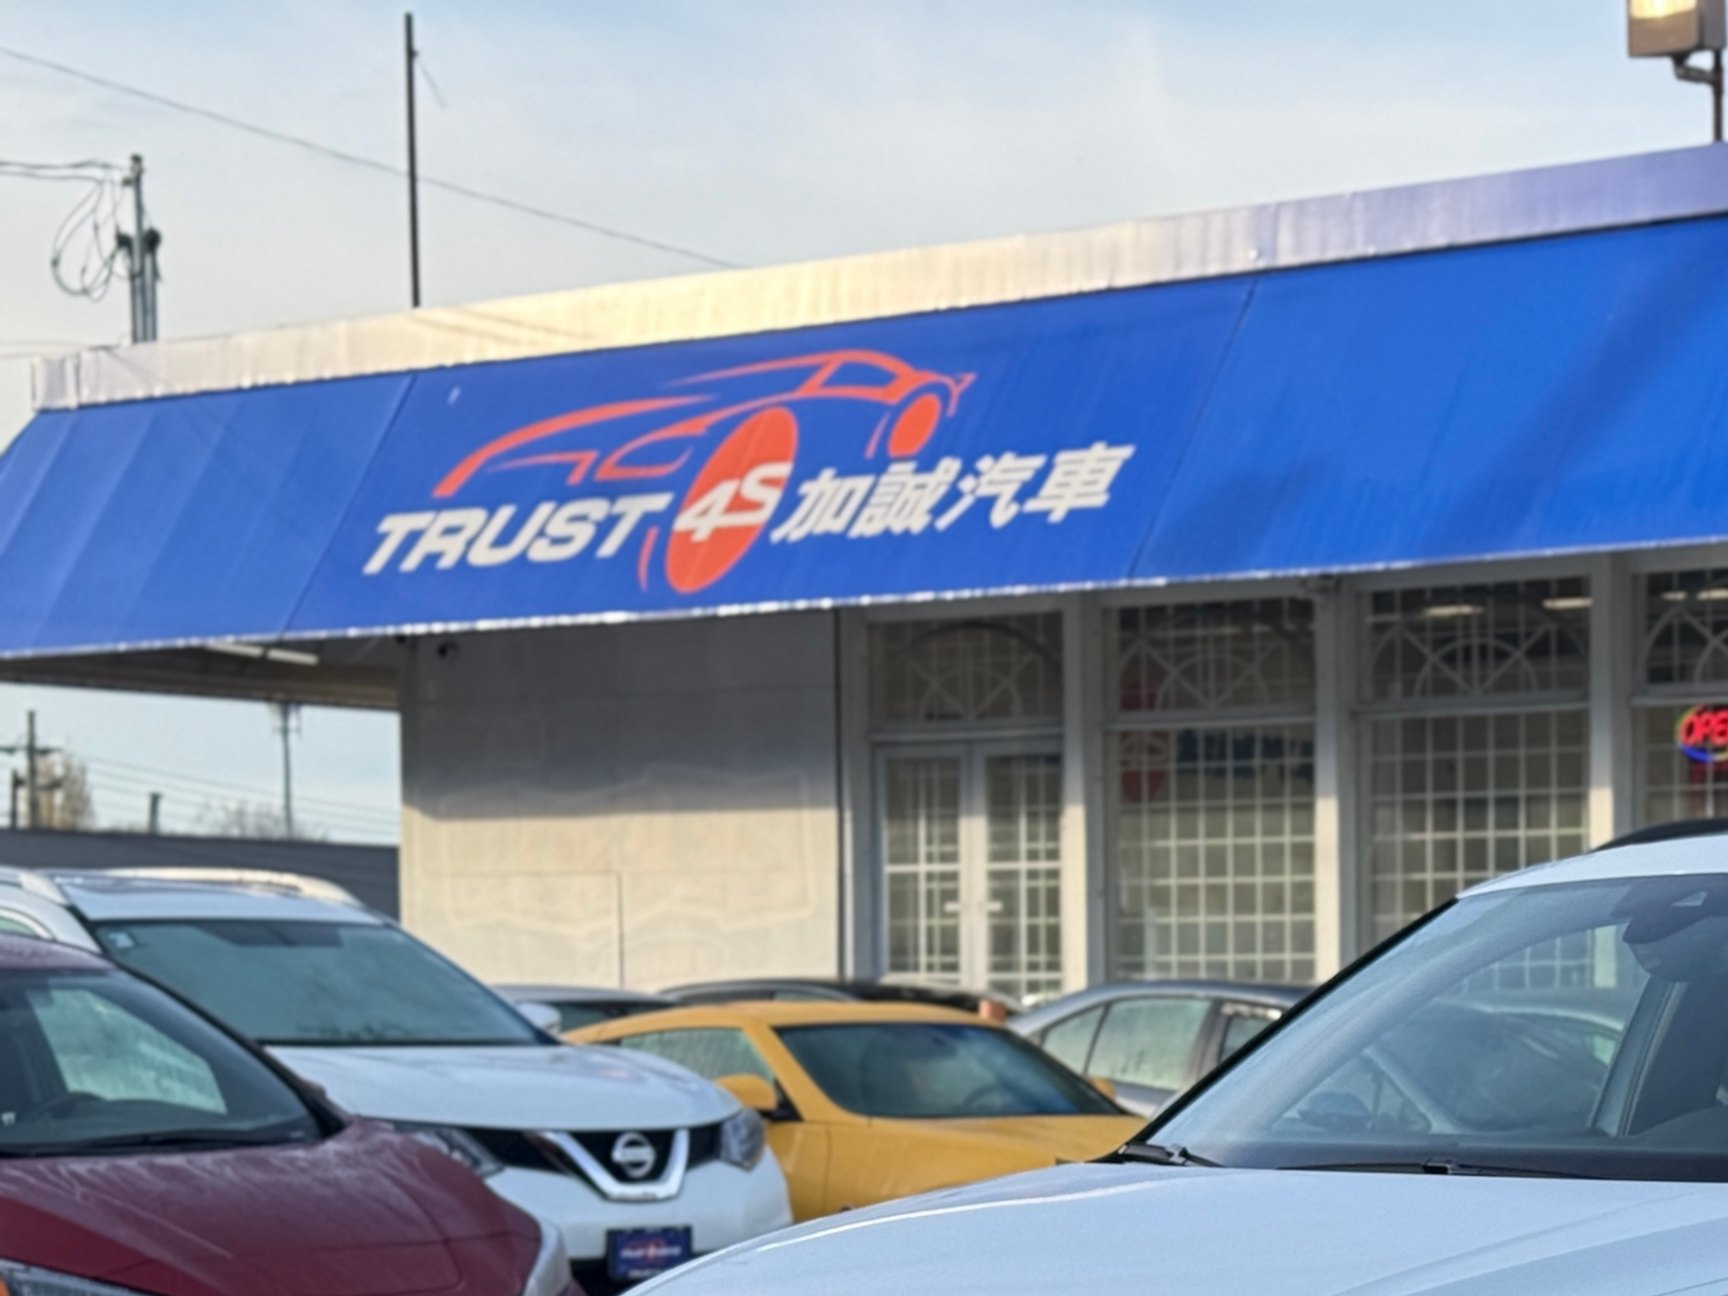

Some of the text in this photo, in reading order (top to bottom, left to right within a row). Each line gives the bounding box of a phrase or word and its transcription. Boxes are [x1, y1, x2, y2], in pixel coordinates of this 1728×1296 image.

[362, 443, 1135, 575] TRUST 4S 加誠汽車
